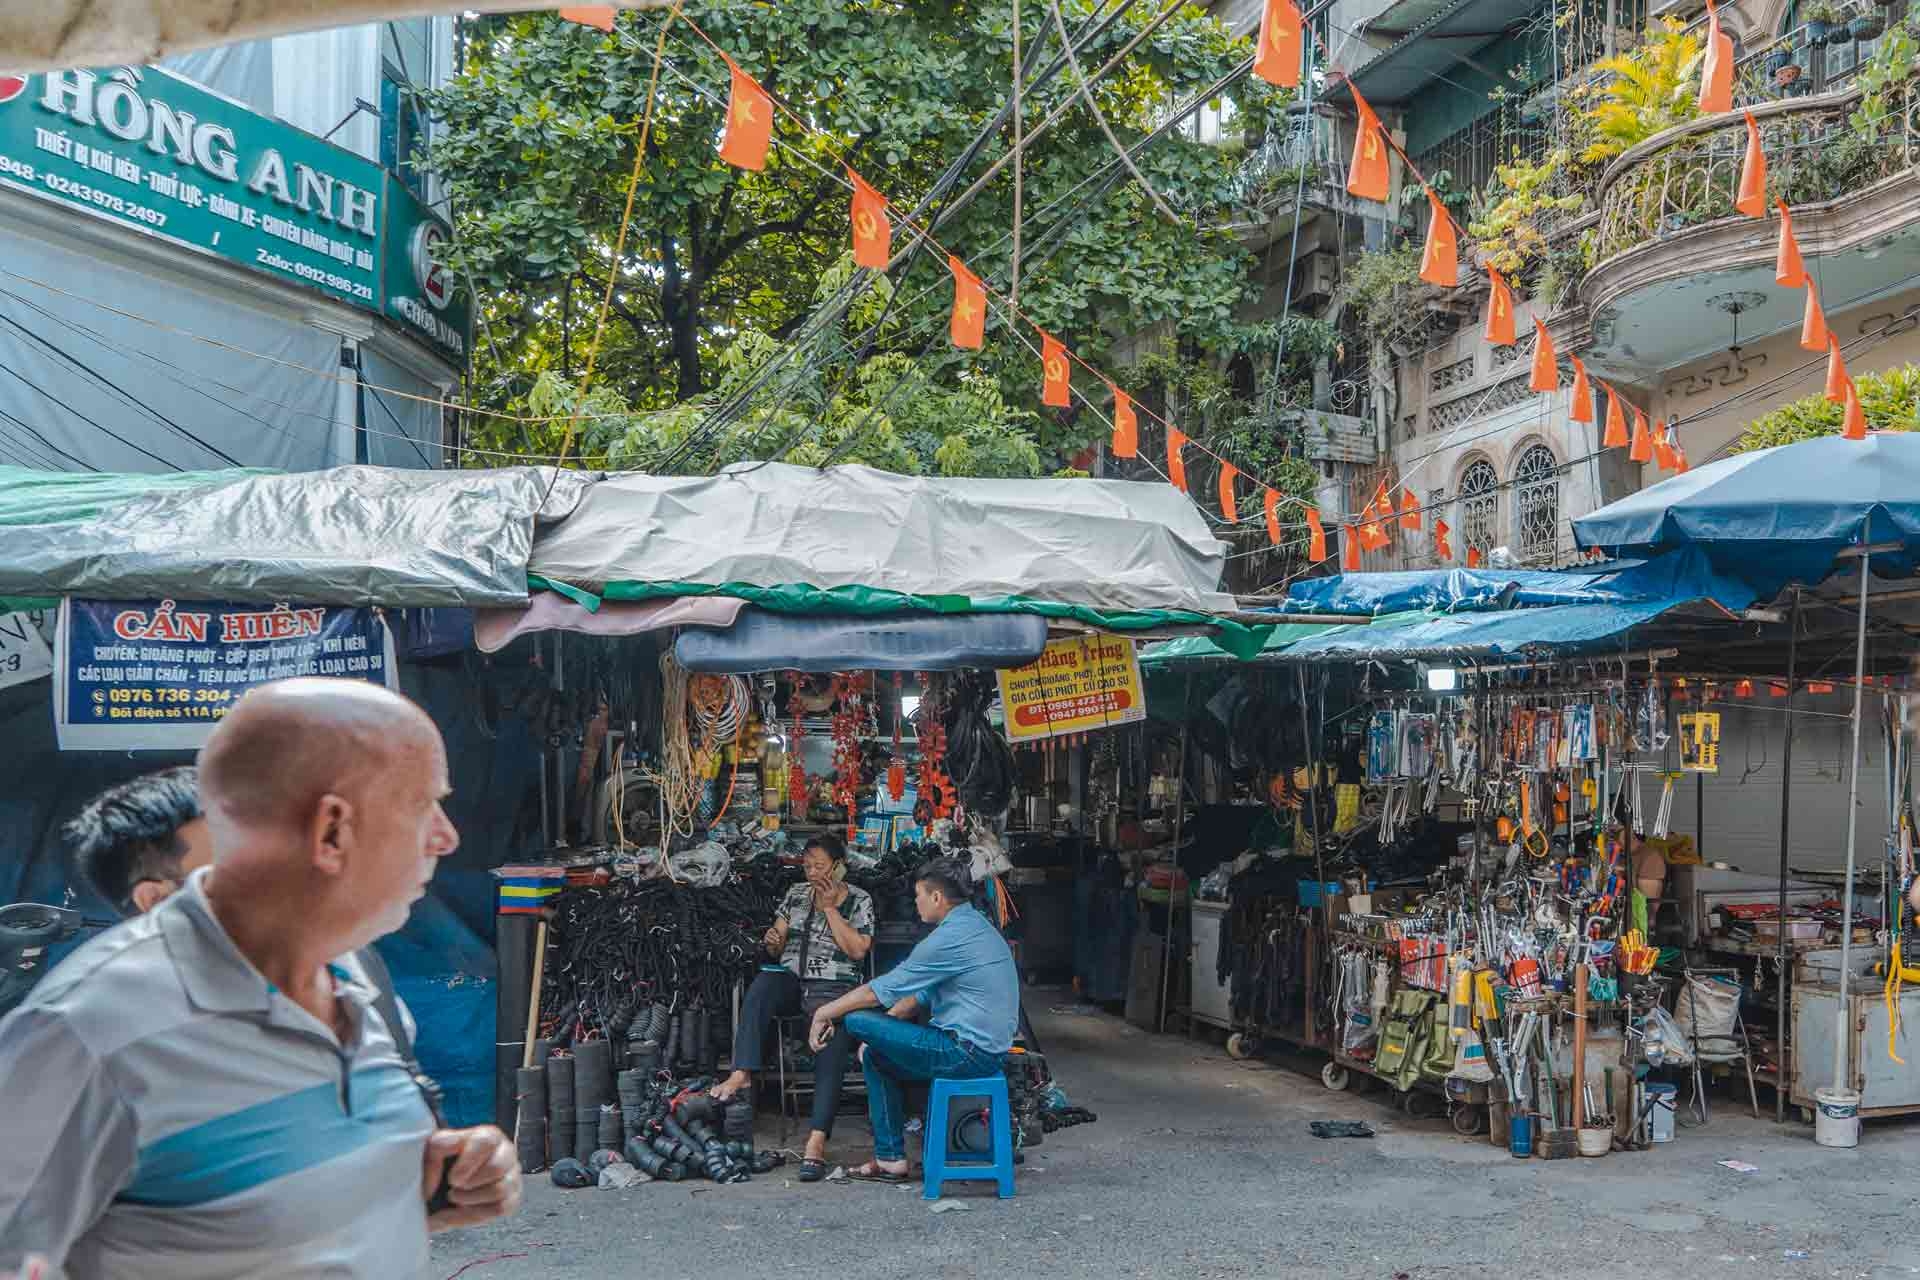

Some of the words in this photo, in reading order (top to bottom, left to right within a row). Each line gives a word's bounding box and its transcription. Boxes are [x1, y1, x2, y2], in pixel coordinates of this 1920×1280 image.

[40, 65, 240, 182] HỒNG
[248, 148, 377, 237] ANH
[35, 127, 72, 160] THIẾT
[74, 141, 89, 169] BỊ
[91, 148, 113, 175] KHÍ
[114, 156, 141, 185] NÉN
[180, 182, 203, 208] LỰC
[240, 205, 256, 229] XE
[261, 213, 300, 245] CHUYÊN
[125, 201, 167, 227] 2497
[256, 248, 293, 273] Zalo:
[219, 601, 326, 642] HIỀN
[94, 643, 139, 661] CHUYÊN:
[323, 635, 342, 652] KHÍ
[78, 664, 101, 681] CÁC
[101, 667, 124, 684] LOẠI
[155, 664, 189, 682] CHẤN
[320, 658, 346, 676] LOẠI
[347, 655, 369, 671] CAO
[370, 655, 382, 669] SU
[109, 688, 153, 703] 0976
[156, 688, 191, 703] 736
[194, 688, 232, 703] 304
[1011, 691, 1027, 704] GIA
[1117, 675, 1129, 686] SU
[134, 706, 165, 719] diện
